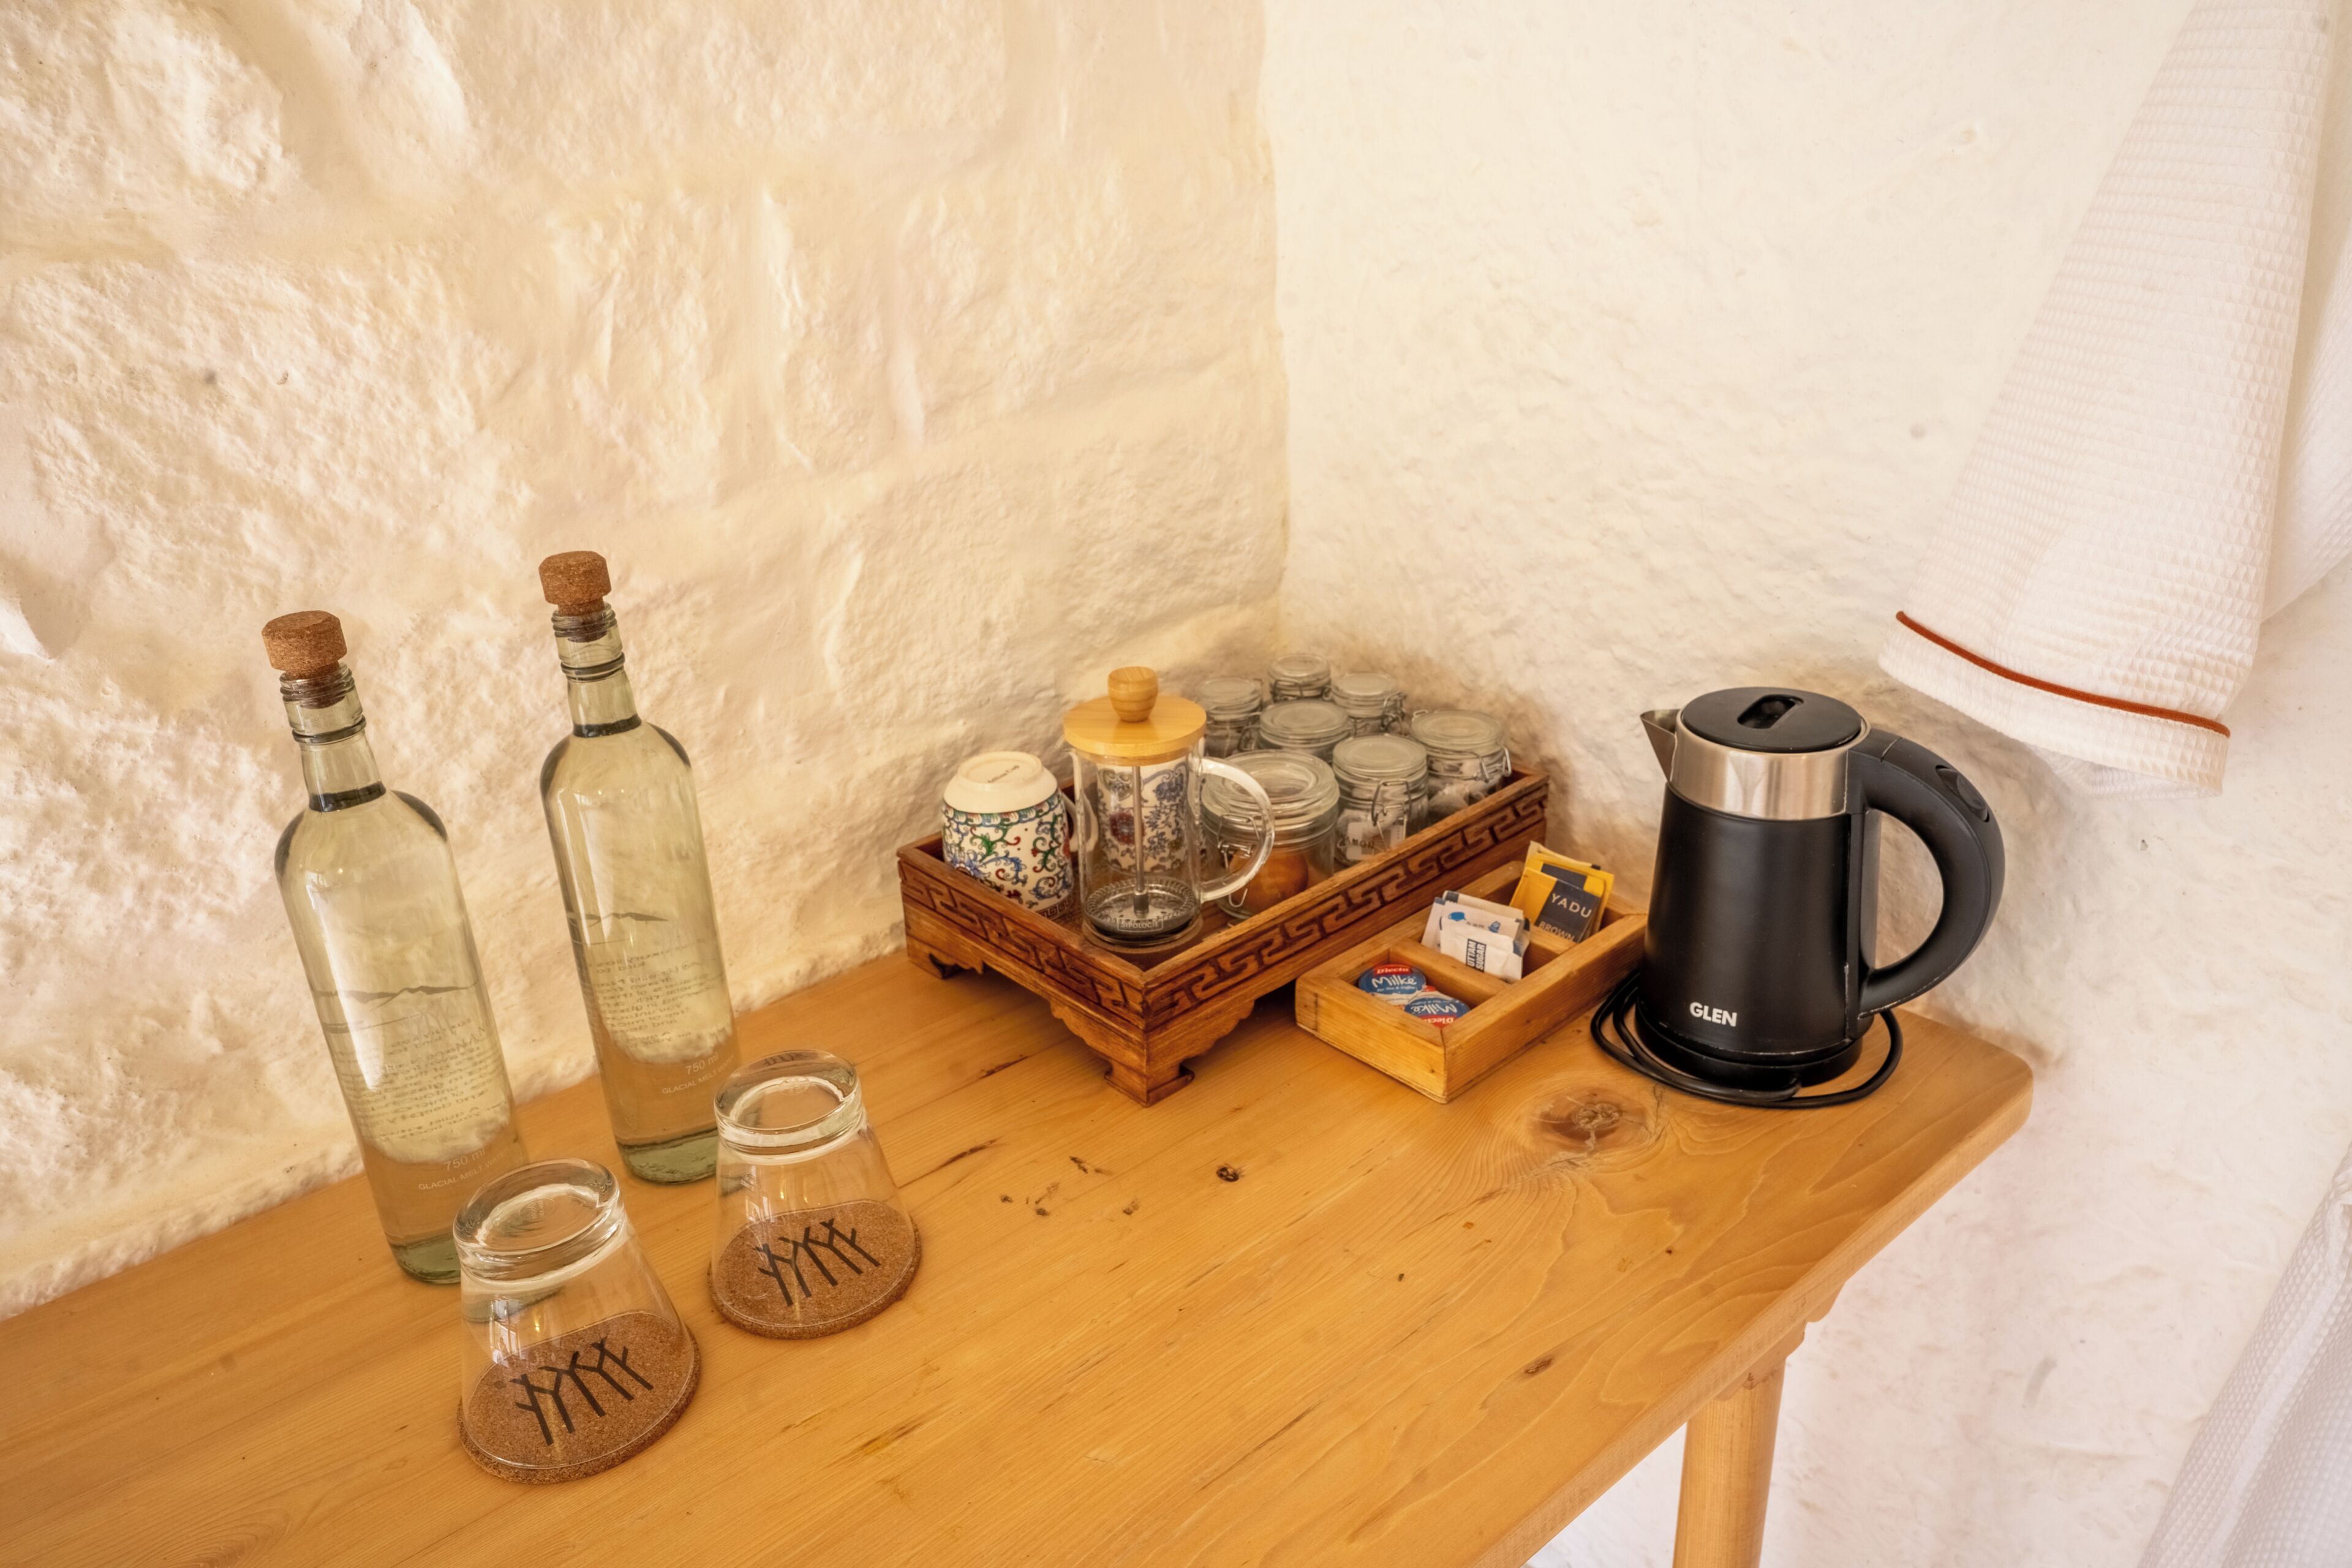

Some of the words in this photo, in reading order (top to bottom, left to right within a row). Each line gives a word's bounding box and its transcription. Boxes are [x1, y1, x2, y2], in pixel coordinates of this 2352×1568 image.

[1551, 893, 1592, 918] YADU
[1538, 921, 1575, 941] BROWN
[1467, 940, 1477, 968] UTTAM
[1476, 943, 1486, 971] SUGAR
[1689, 1001, 1738, 1027] GLEN
[685, 1060, 706, 1075] 750
[707, 1052, 719, 1065] ml
[662, 1080, 698, 1094] GLACIAL
[698, 1069, 717, 1083] MELT
[445, 1155, 469, 1171] 750
[472, 1147, 486, 1161] ml
[418, 1177, 459, 1190] GLACIAL
[461, 1165, 483, 1181] MELT
